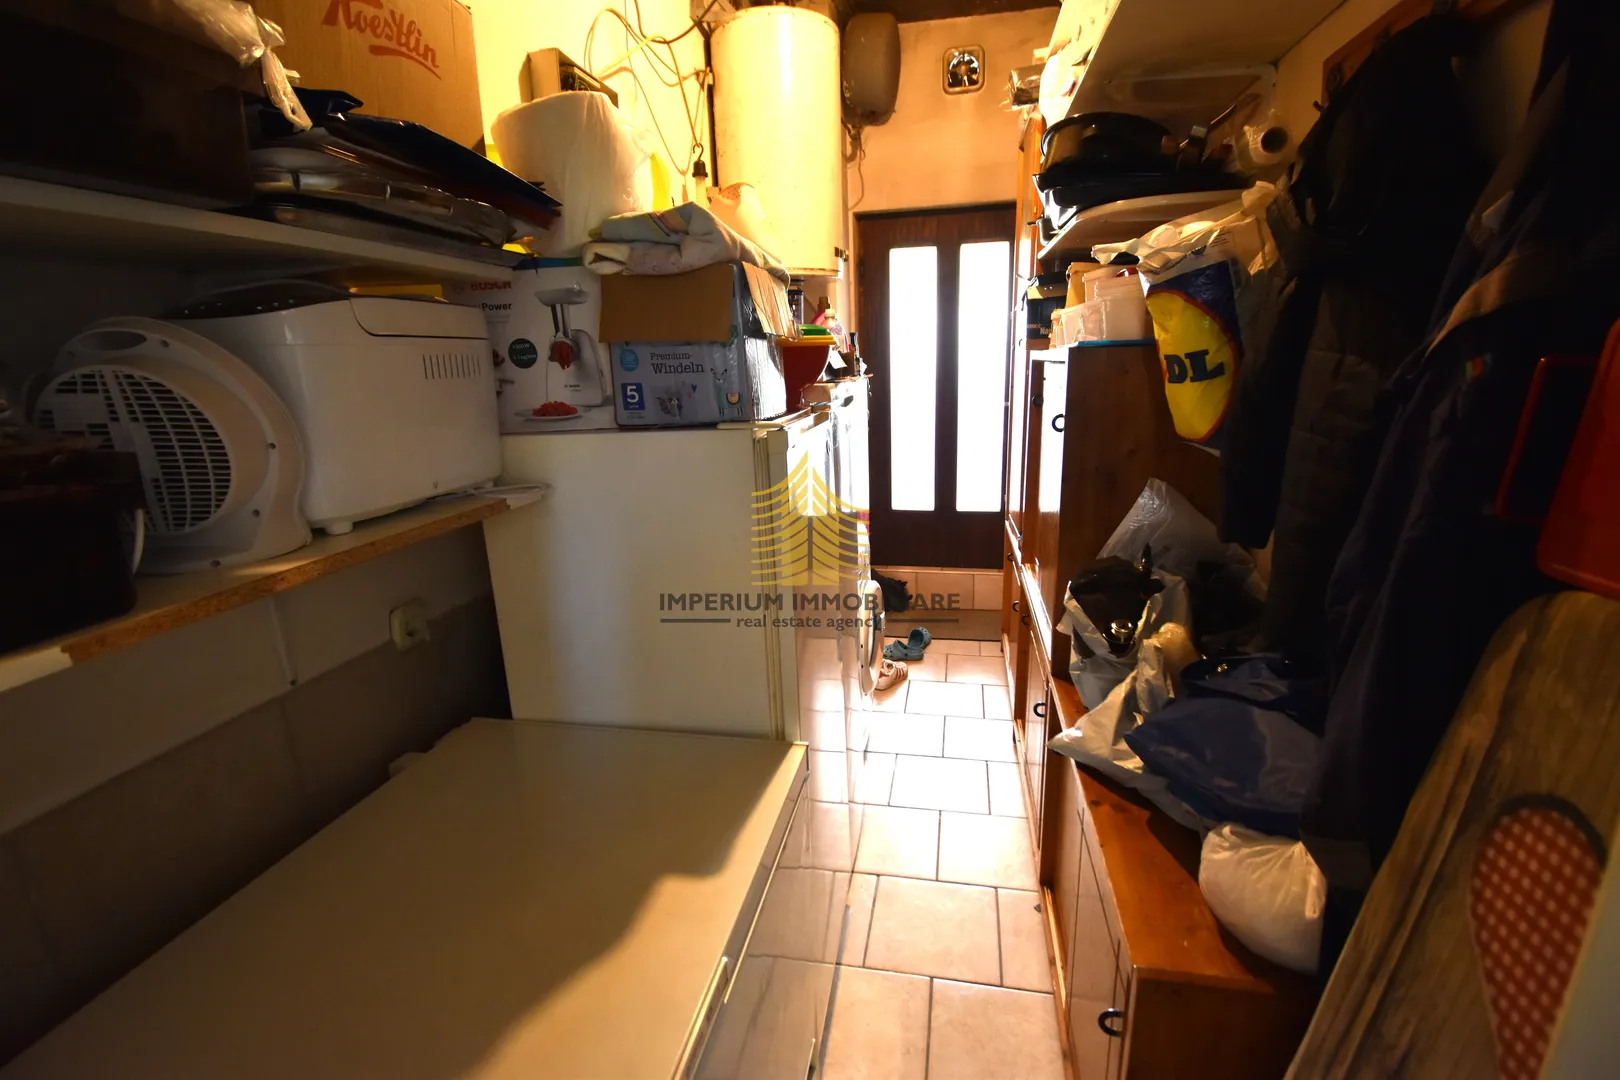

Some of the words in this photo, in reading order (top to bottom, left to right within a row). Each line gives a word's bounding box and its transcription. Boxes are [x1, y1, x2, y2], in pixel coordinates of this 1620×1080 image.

[478, 302, 512, 311] Power
[650, 352, 692, 361] Premium-
[651, 362, 704, 374] Windeln
[1164, 349, 1226, 384] DL
[626, 385, 639, 403] 5
